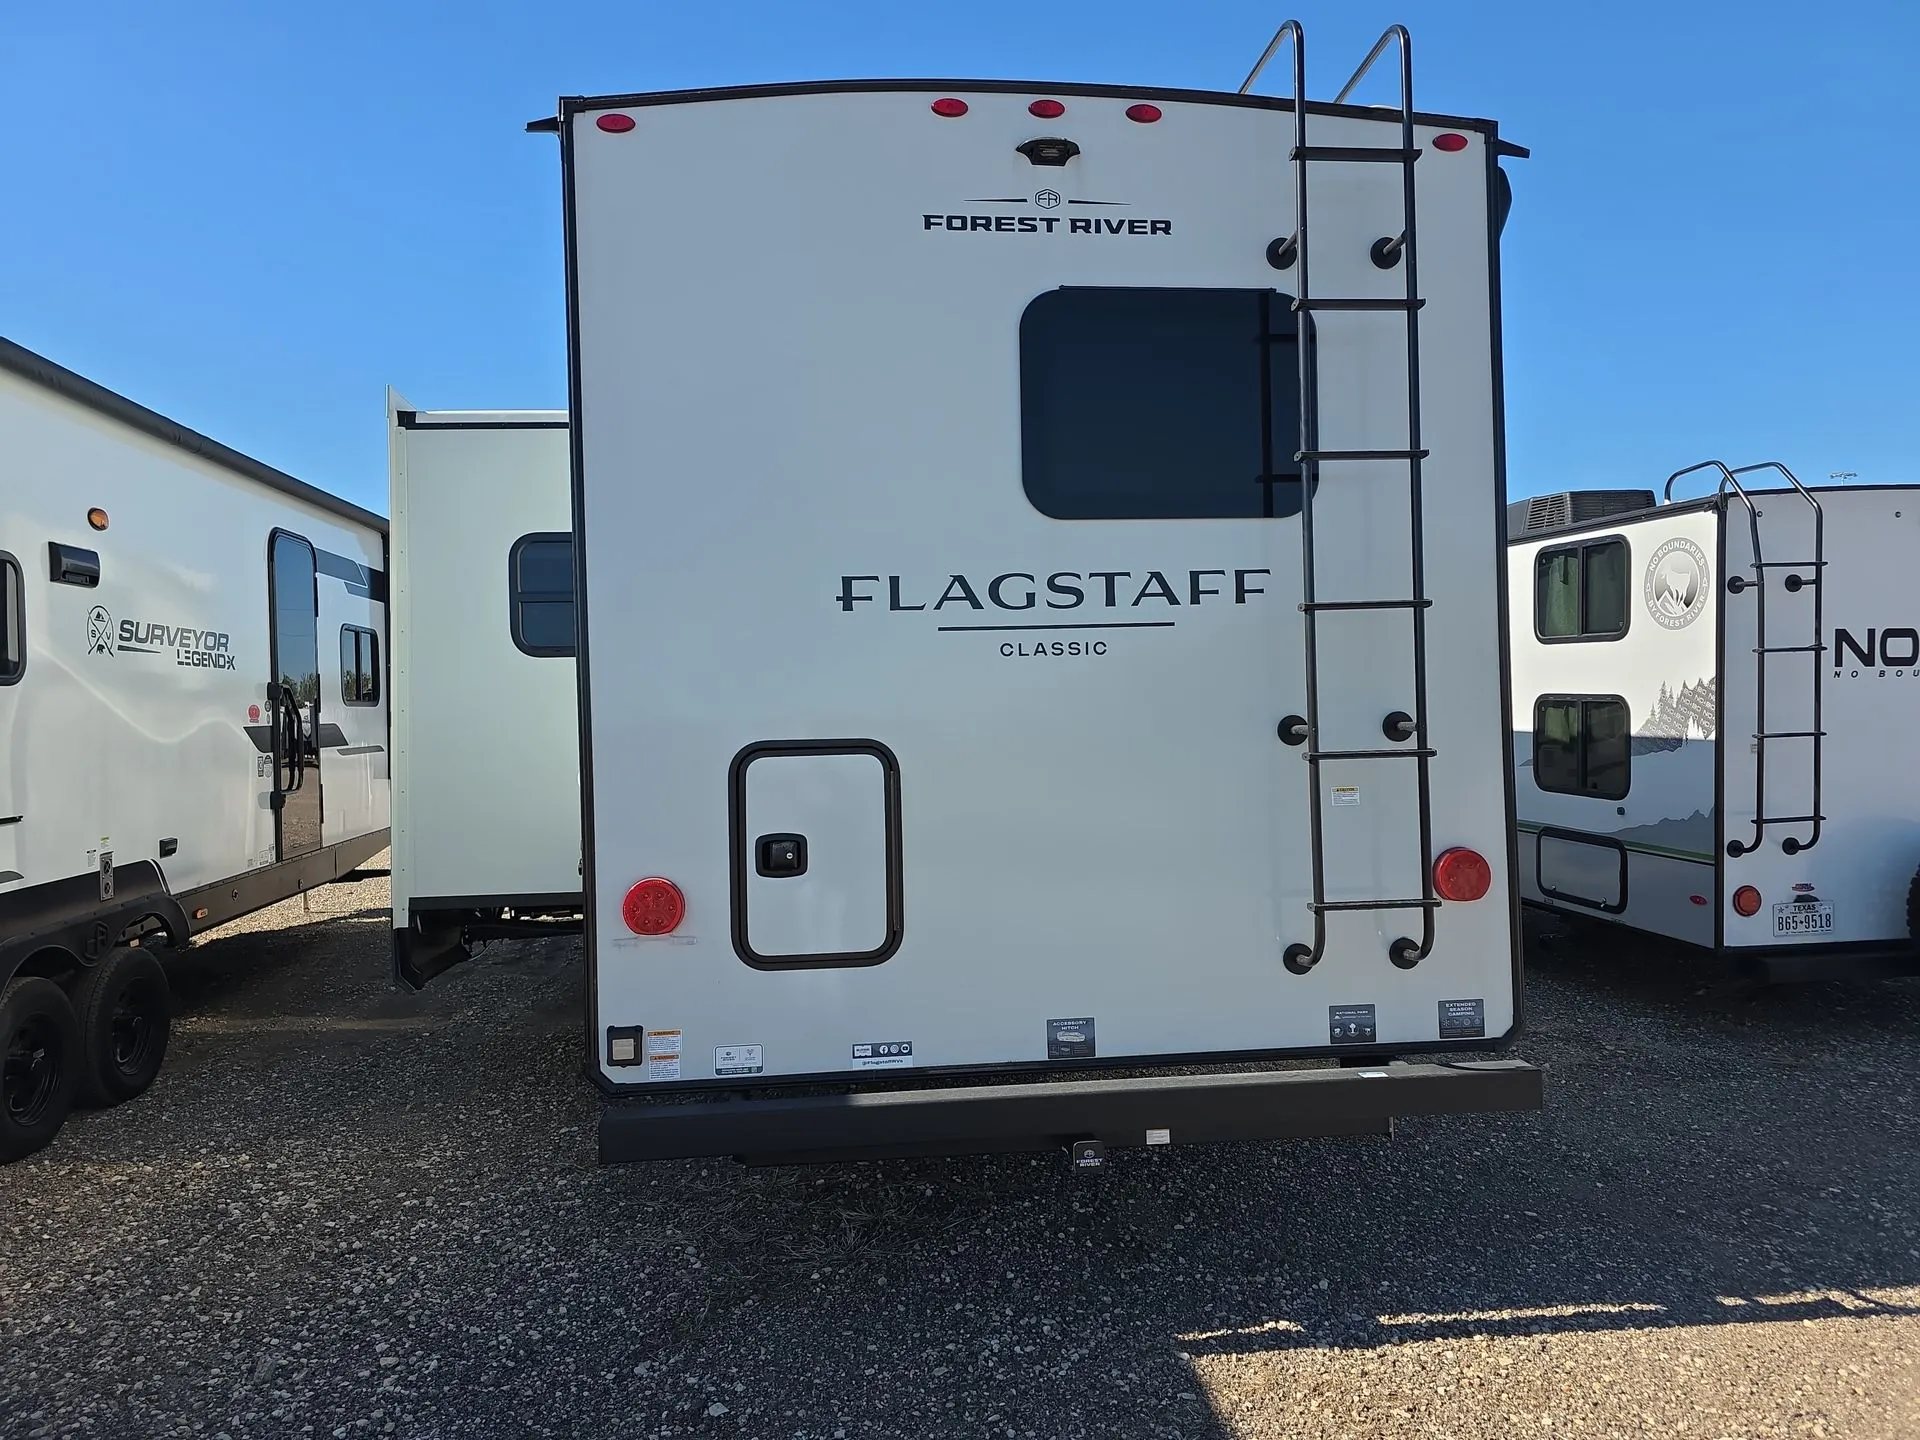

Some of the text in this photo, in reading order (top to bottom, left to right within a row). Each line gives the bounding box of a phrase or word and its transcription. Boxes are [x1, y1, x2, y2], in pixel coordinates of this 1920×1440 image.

[922, 214, 1172, 235] FOREST RIVER
[1649, 540, 1704, 571] NO BOUNDARIES
[836, 568, 1271, 612] FLAGSTAFF
[1648, 596, 1705, 627] BY FOREST RIVER
[119, 619, 229, 652] SURVEYOR
[1000, 641, 1107, 657] CLASSIC
[1835, 628, 1920, 667] NO
[1834, 670, 1858, 678] NO
